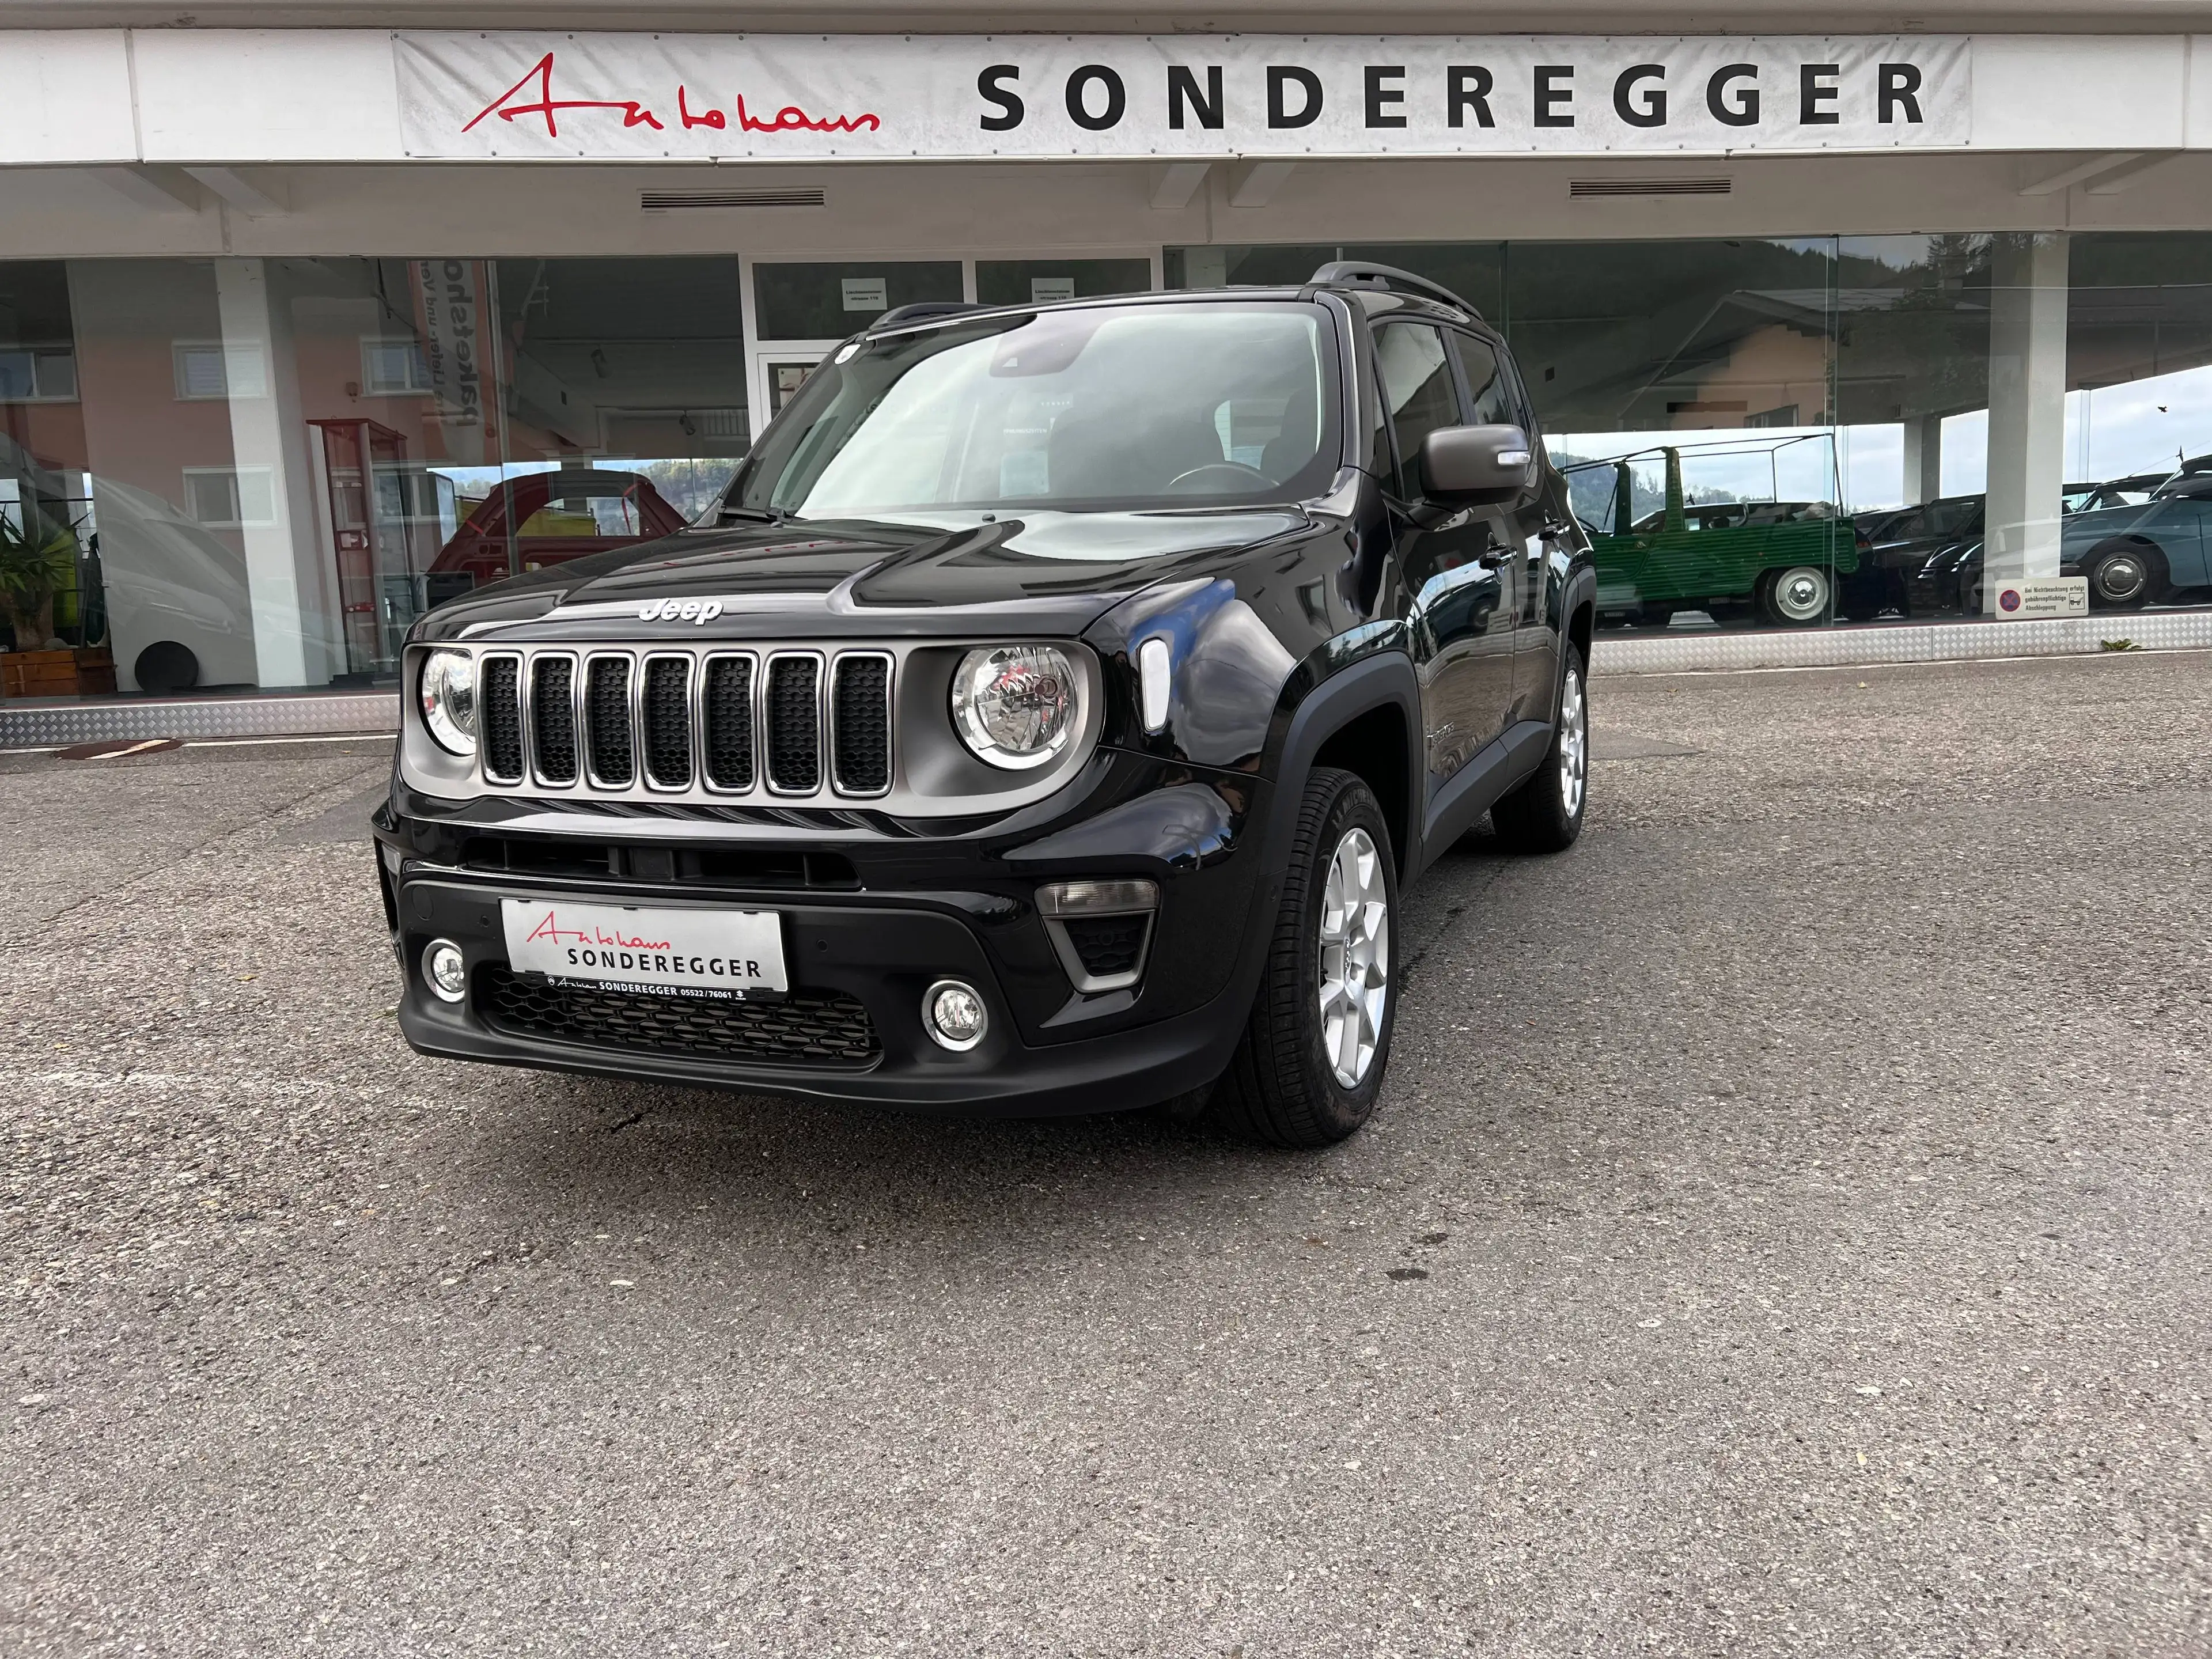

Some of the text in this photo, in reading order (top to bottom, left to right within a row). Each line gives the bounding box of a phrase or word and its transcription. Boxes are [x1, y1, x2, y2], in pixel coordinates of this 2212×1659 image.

[461, 52, 1924, 138] Autohaus SONDEREGGER
[639, 598, 724, 626] Jeep
[526, 910, 672, 950] Autohaus
[567, 948, 762, 979] SONDEREGGER
[599, 981, 678, 996] SONDEREGGER
